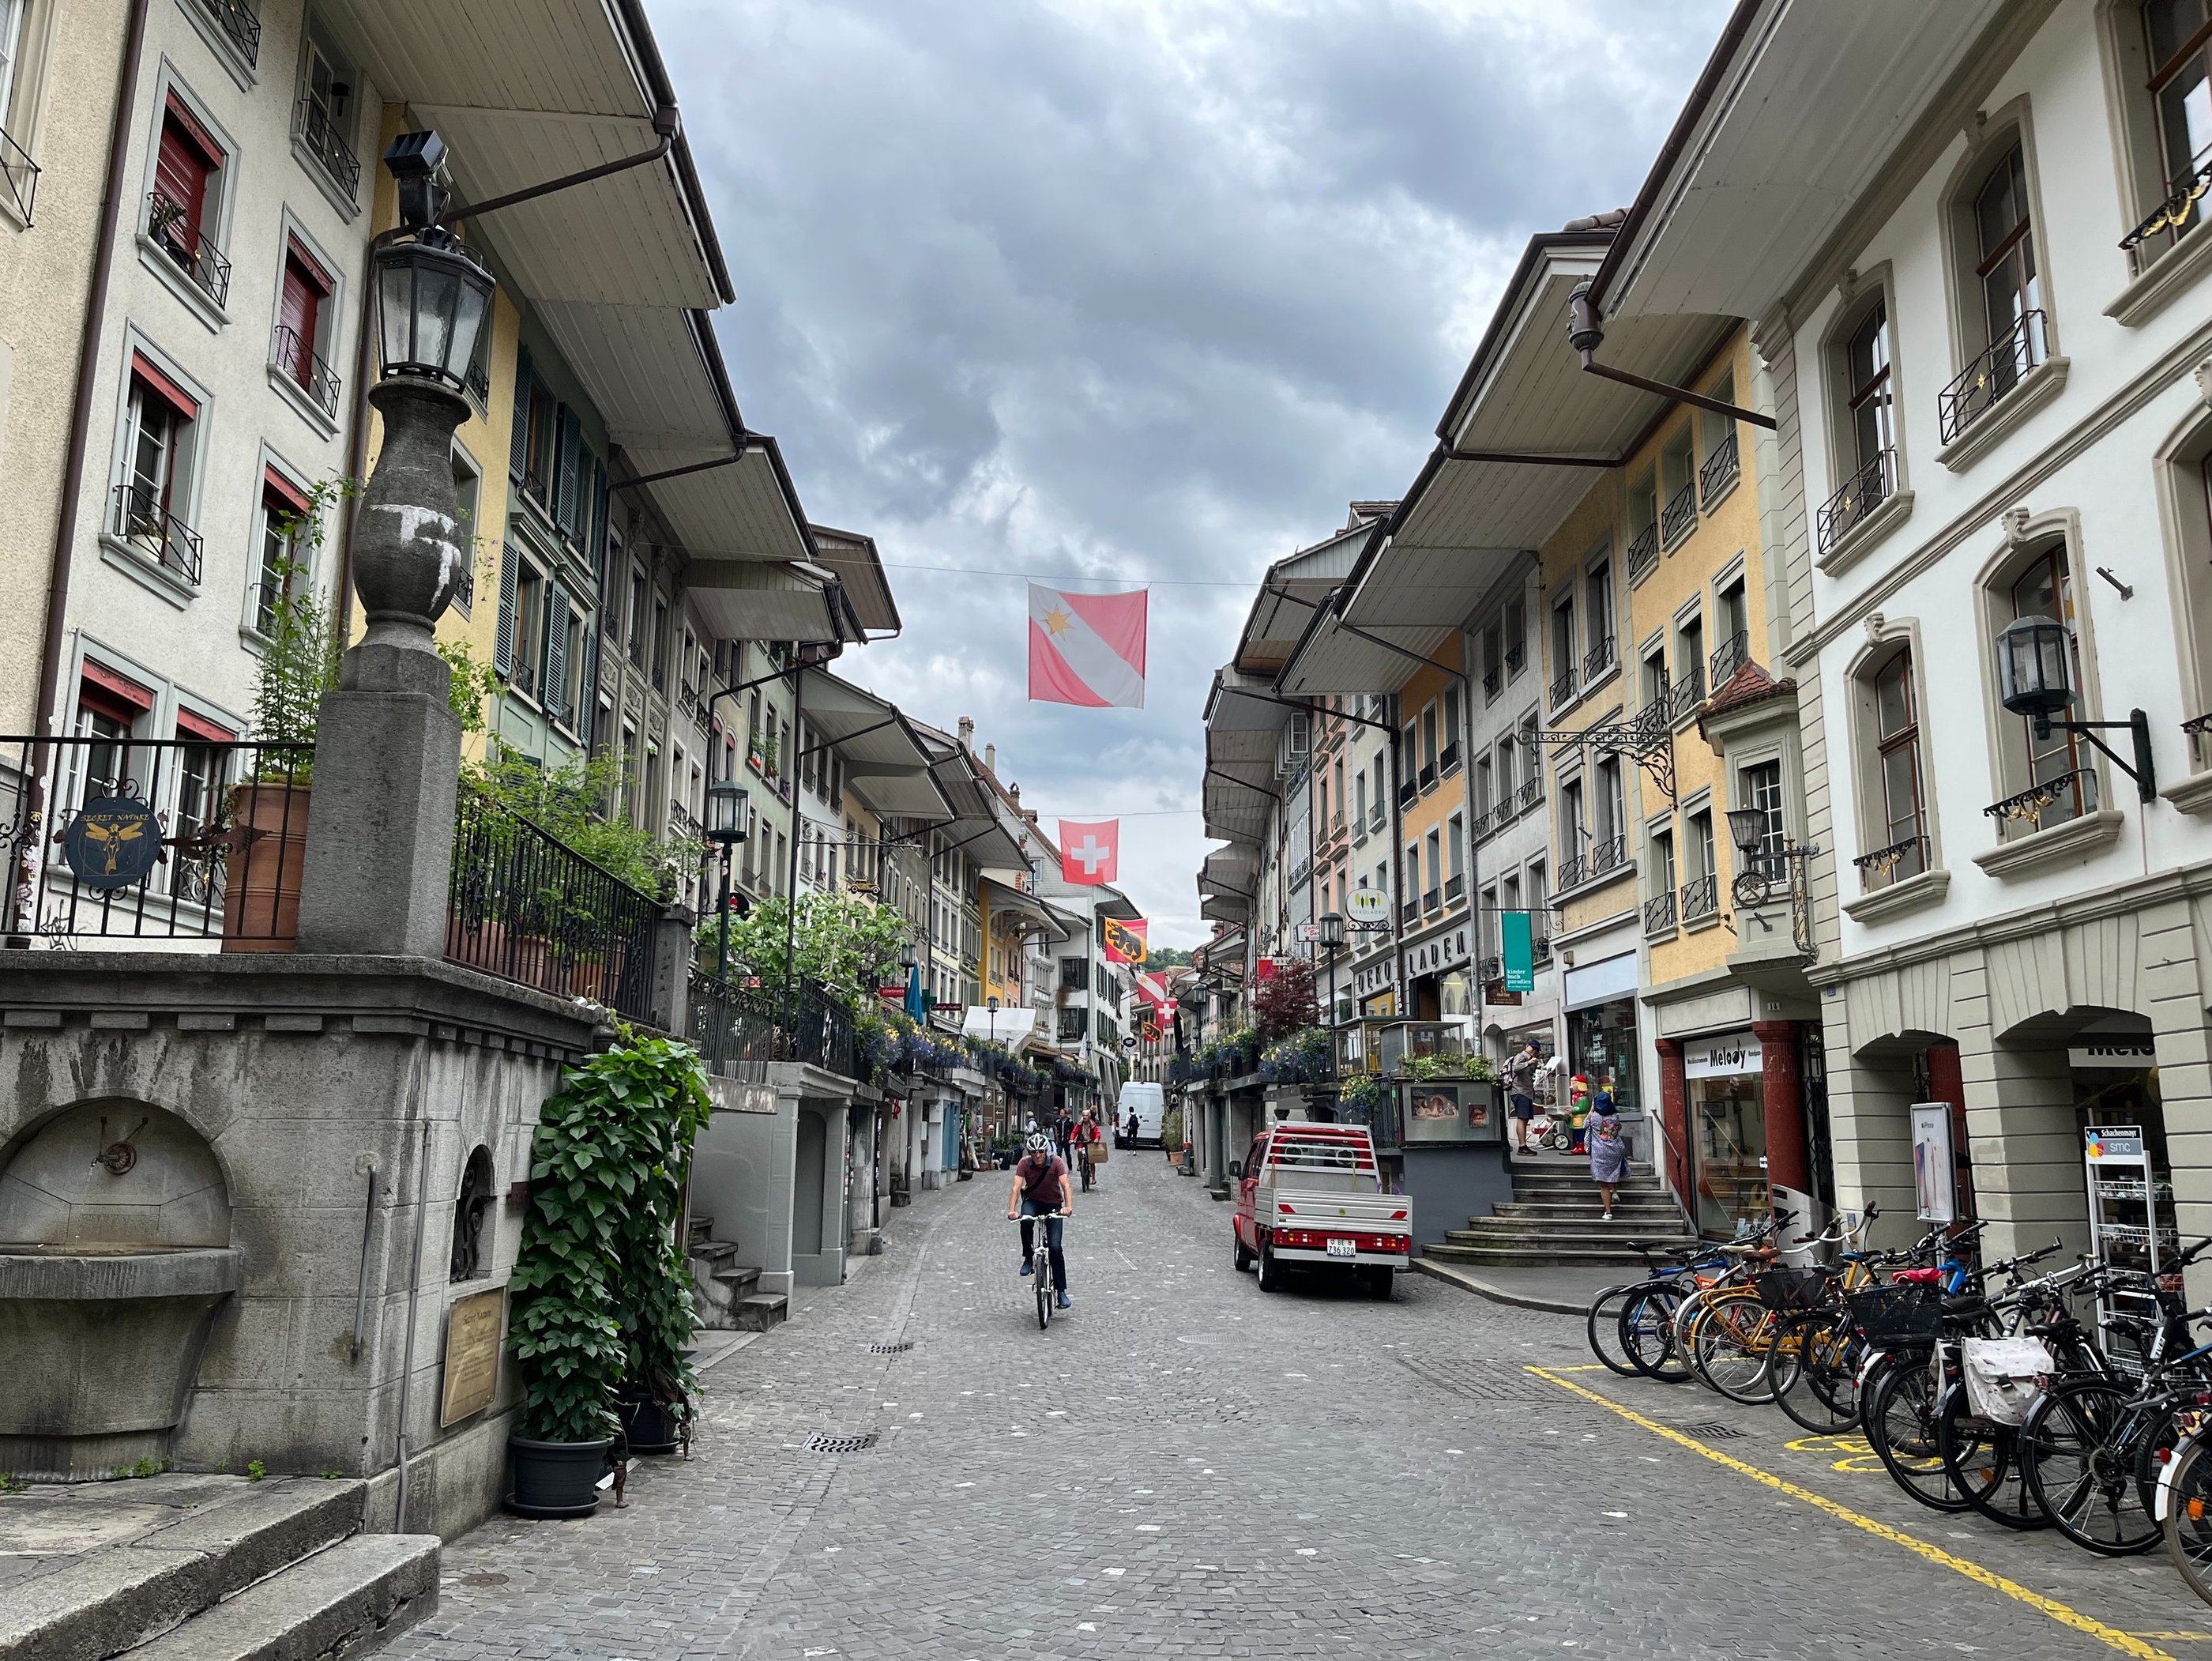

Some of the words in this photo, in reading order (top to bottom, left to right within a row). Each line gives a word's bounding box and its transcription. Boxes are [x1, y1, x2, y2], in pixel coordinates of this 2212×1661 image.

[1357, 960, 1392, 995] OEKO
[1409, 930, 1465, 976] LADEN
[1710, 1038, 1746, 1069] Melody
[2101, 1129, 2137, 1138] Schachenmayr
[2110, 1143, 2131, 1152] smc
